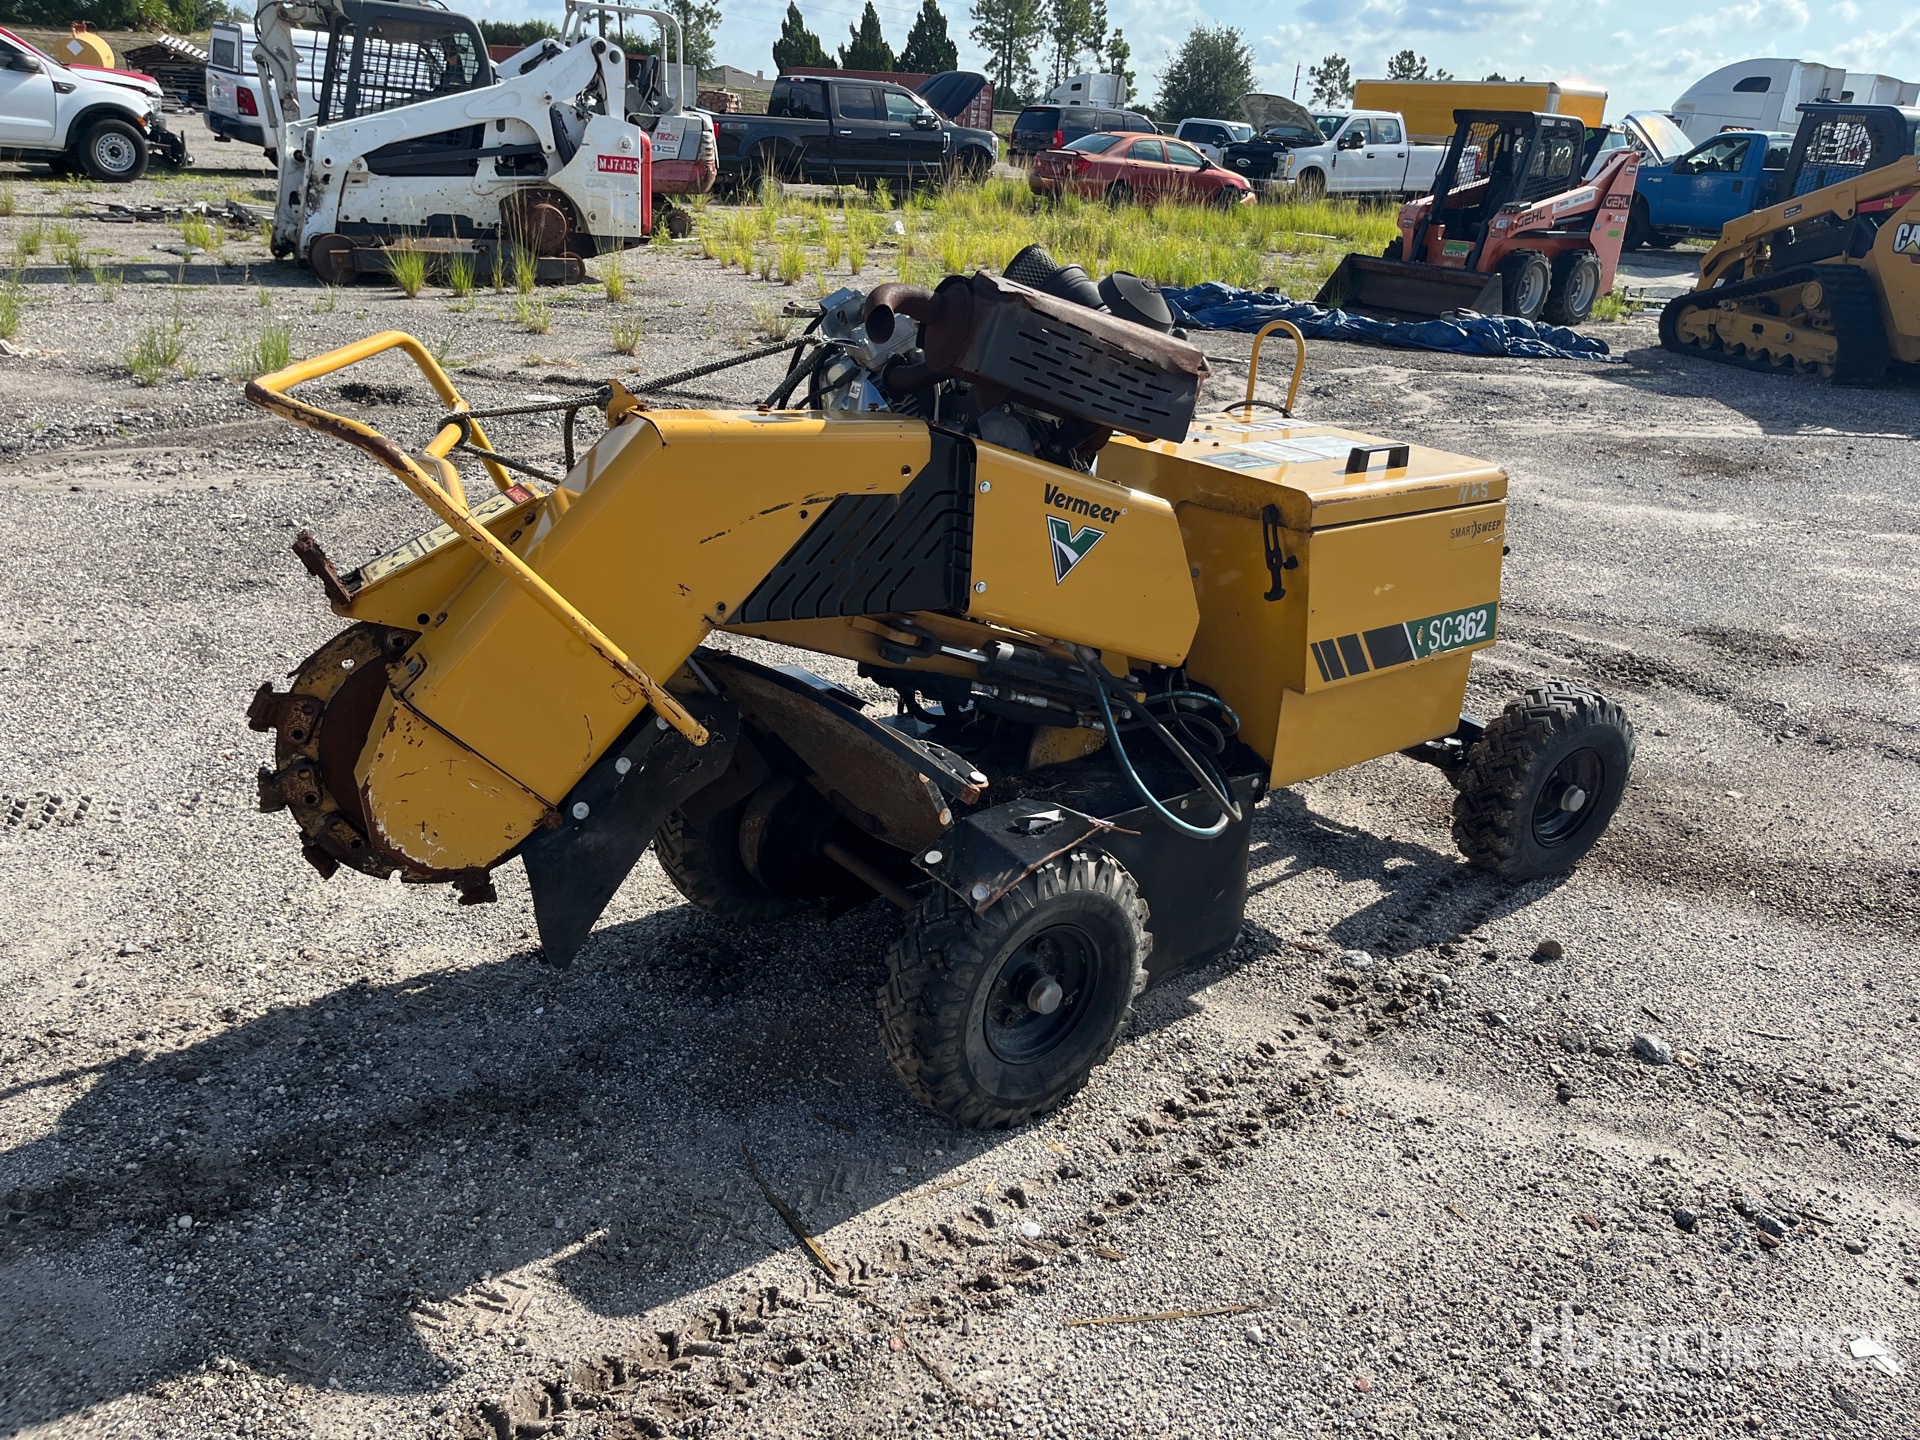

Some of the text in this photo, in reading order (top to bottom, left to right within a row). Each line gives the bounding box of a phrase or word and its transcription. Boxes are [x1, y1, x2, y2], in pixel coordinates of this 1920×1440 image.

[1605, 195, 1629, 208] GEHL
[1517, 208, 1547, 228] GEHL
[1894, 223, 1920, 253] CA
[1043, 482, 1121, 524] Vermeer
[1428, 609, 1488, 650] SC362
